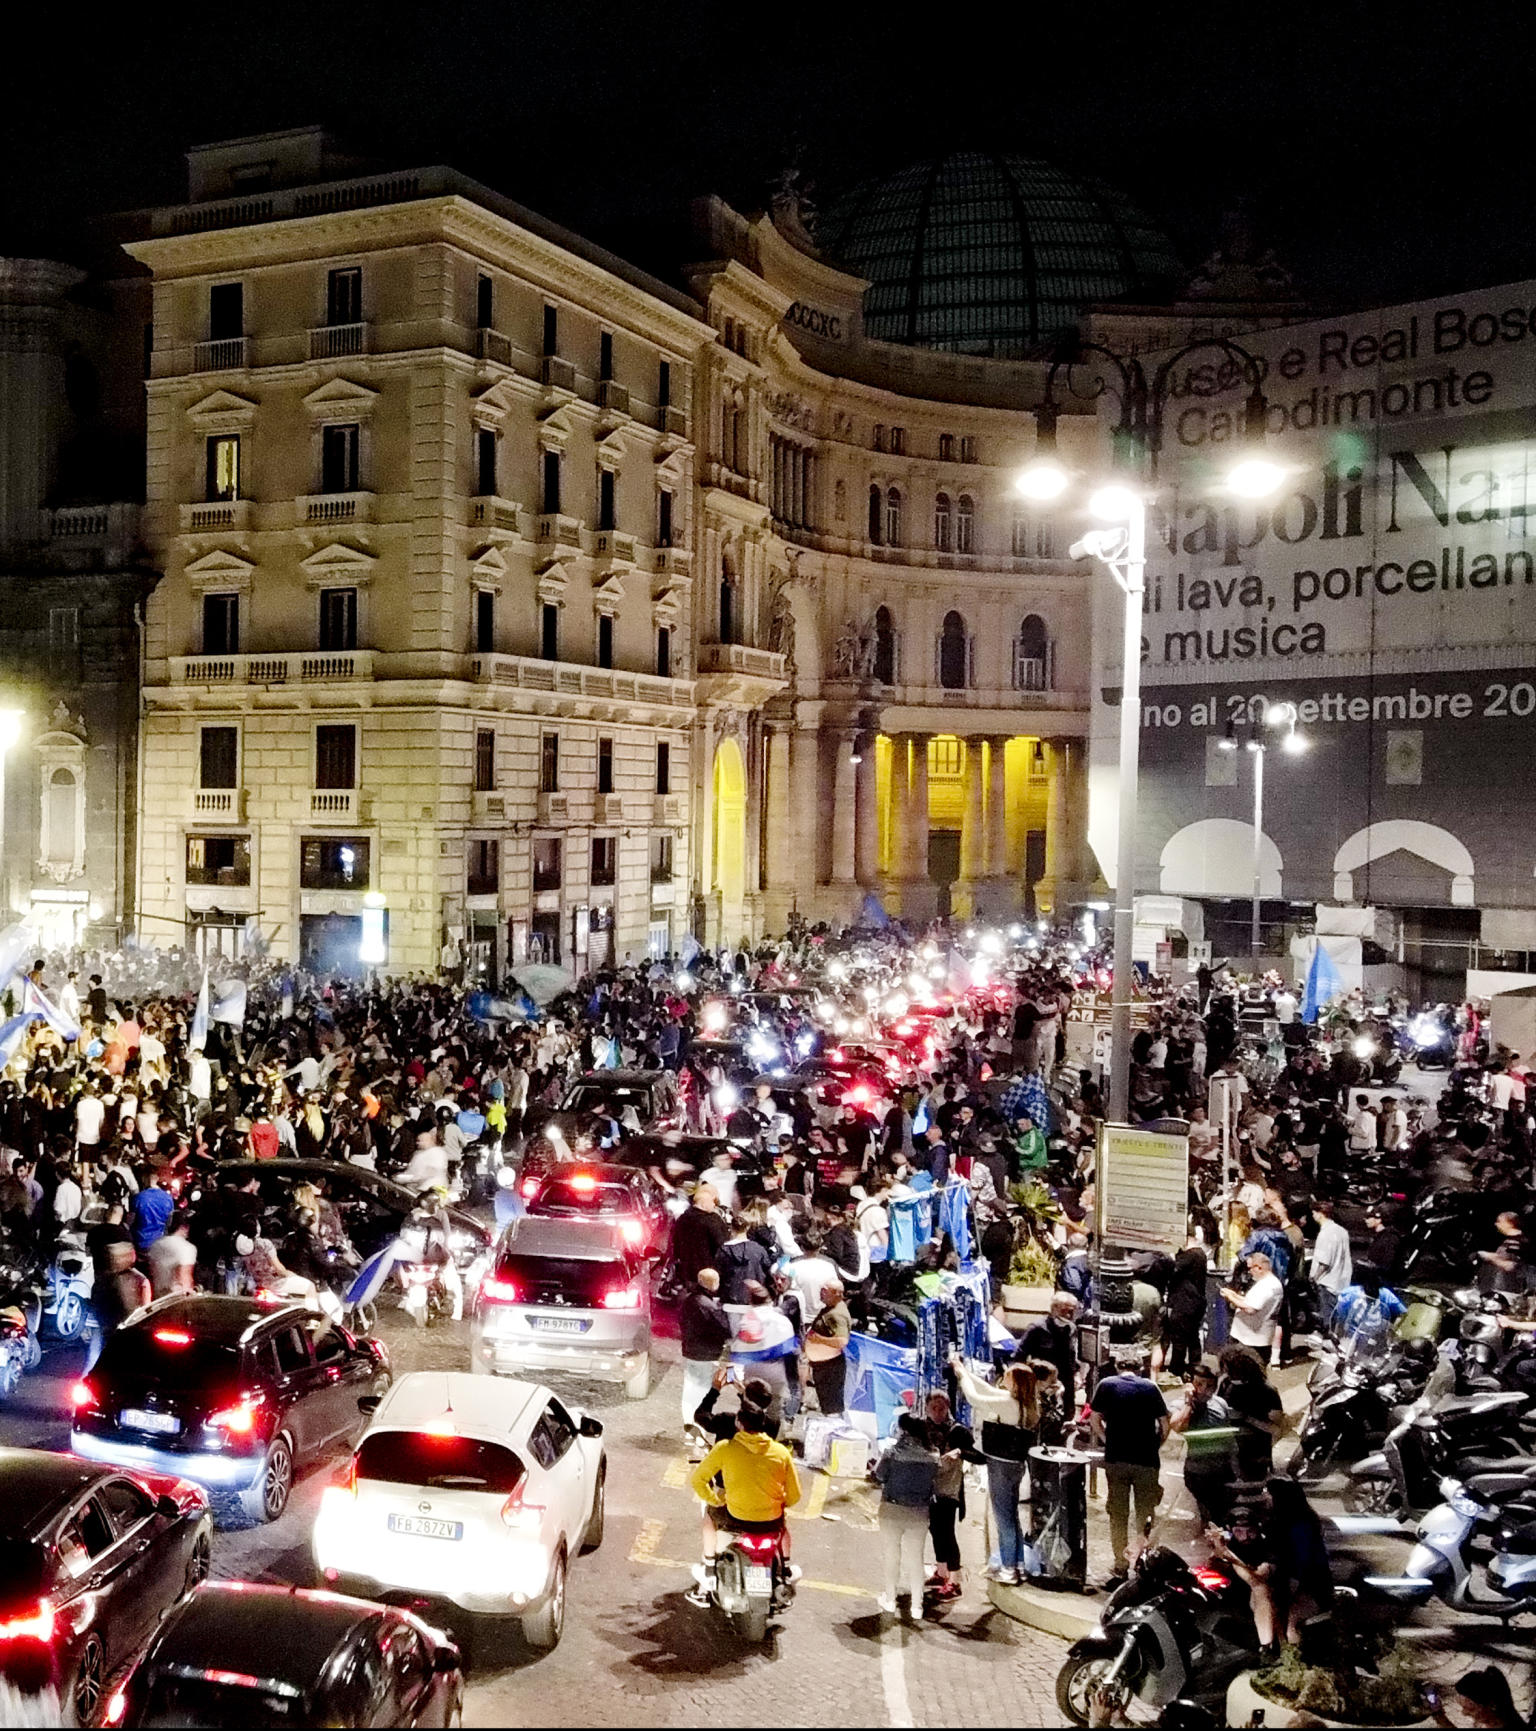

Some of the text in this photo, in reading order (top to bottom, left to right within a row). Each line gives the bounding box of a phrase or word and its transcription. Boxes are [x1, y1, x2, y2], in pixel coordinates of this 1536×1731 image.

[1167, 306, 1536, 398] useo e Real Bos
[1177, 572, 1277, 613] lava,
[1164, 616, 1326, 662] musica
[1189, 696, 1217, 726] al
[1278, 687, 1473, 724] ettembre
[397, 1517, 412, 1531] FB
